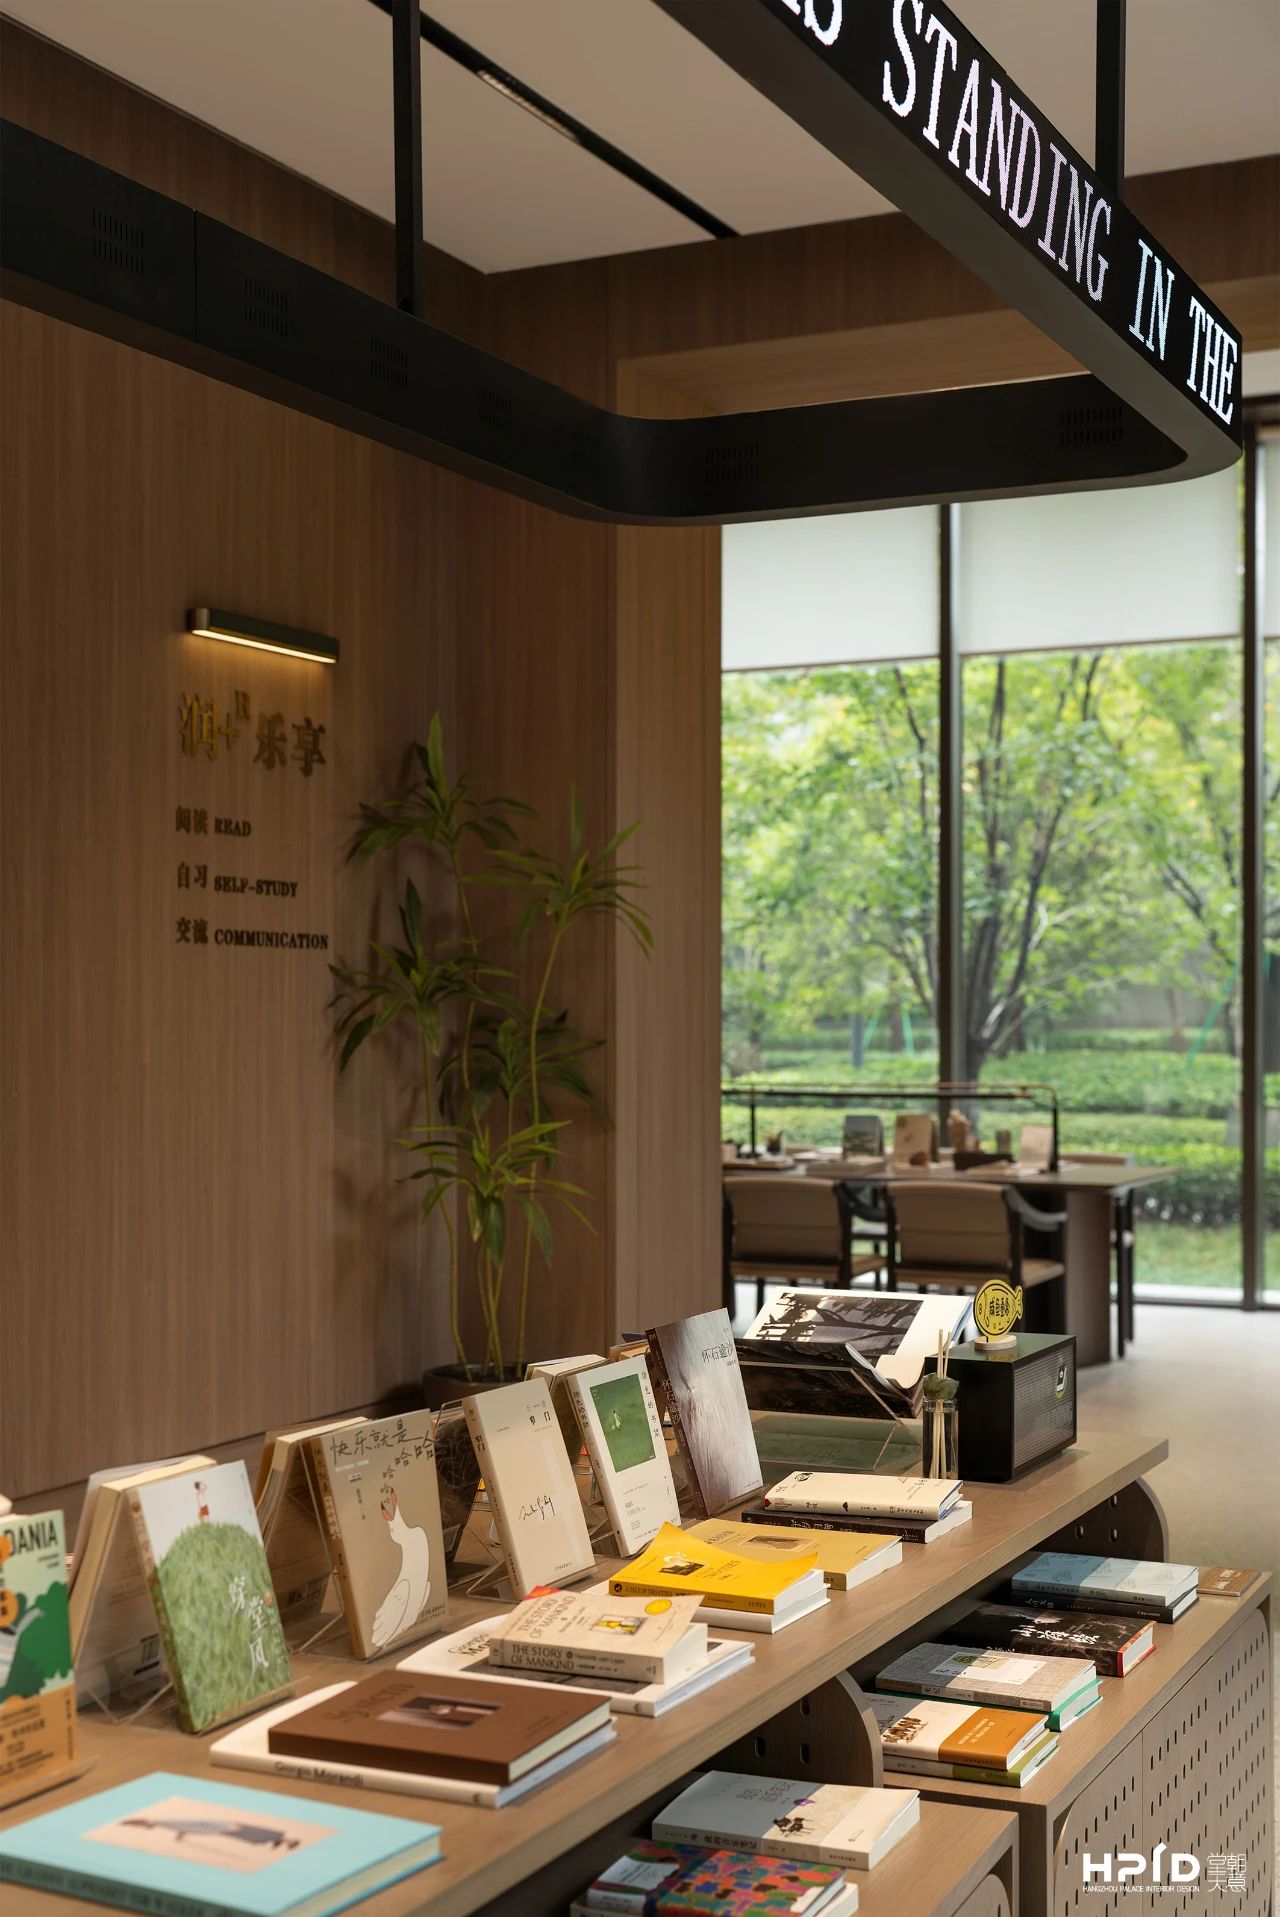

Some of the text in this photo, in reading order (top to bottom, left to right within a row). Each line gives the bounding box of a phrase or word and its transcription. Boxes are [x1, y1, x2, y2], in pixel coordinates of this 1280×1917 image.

[882, 0, 1238, 426] STANDING IN THE
[175, 805, 252, 837] 阅读 READ
[177, 862, 298, 898] 自习 SELF-STUDY
[175, 916, 328, 950] 交流 COMMUNICATION
[510, 1654, 525, 1665] OF
[526, 1656, 575, 1671] MANKIND
[512, 1644, 563, 1660] THE STORY
